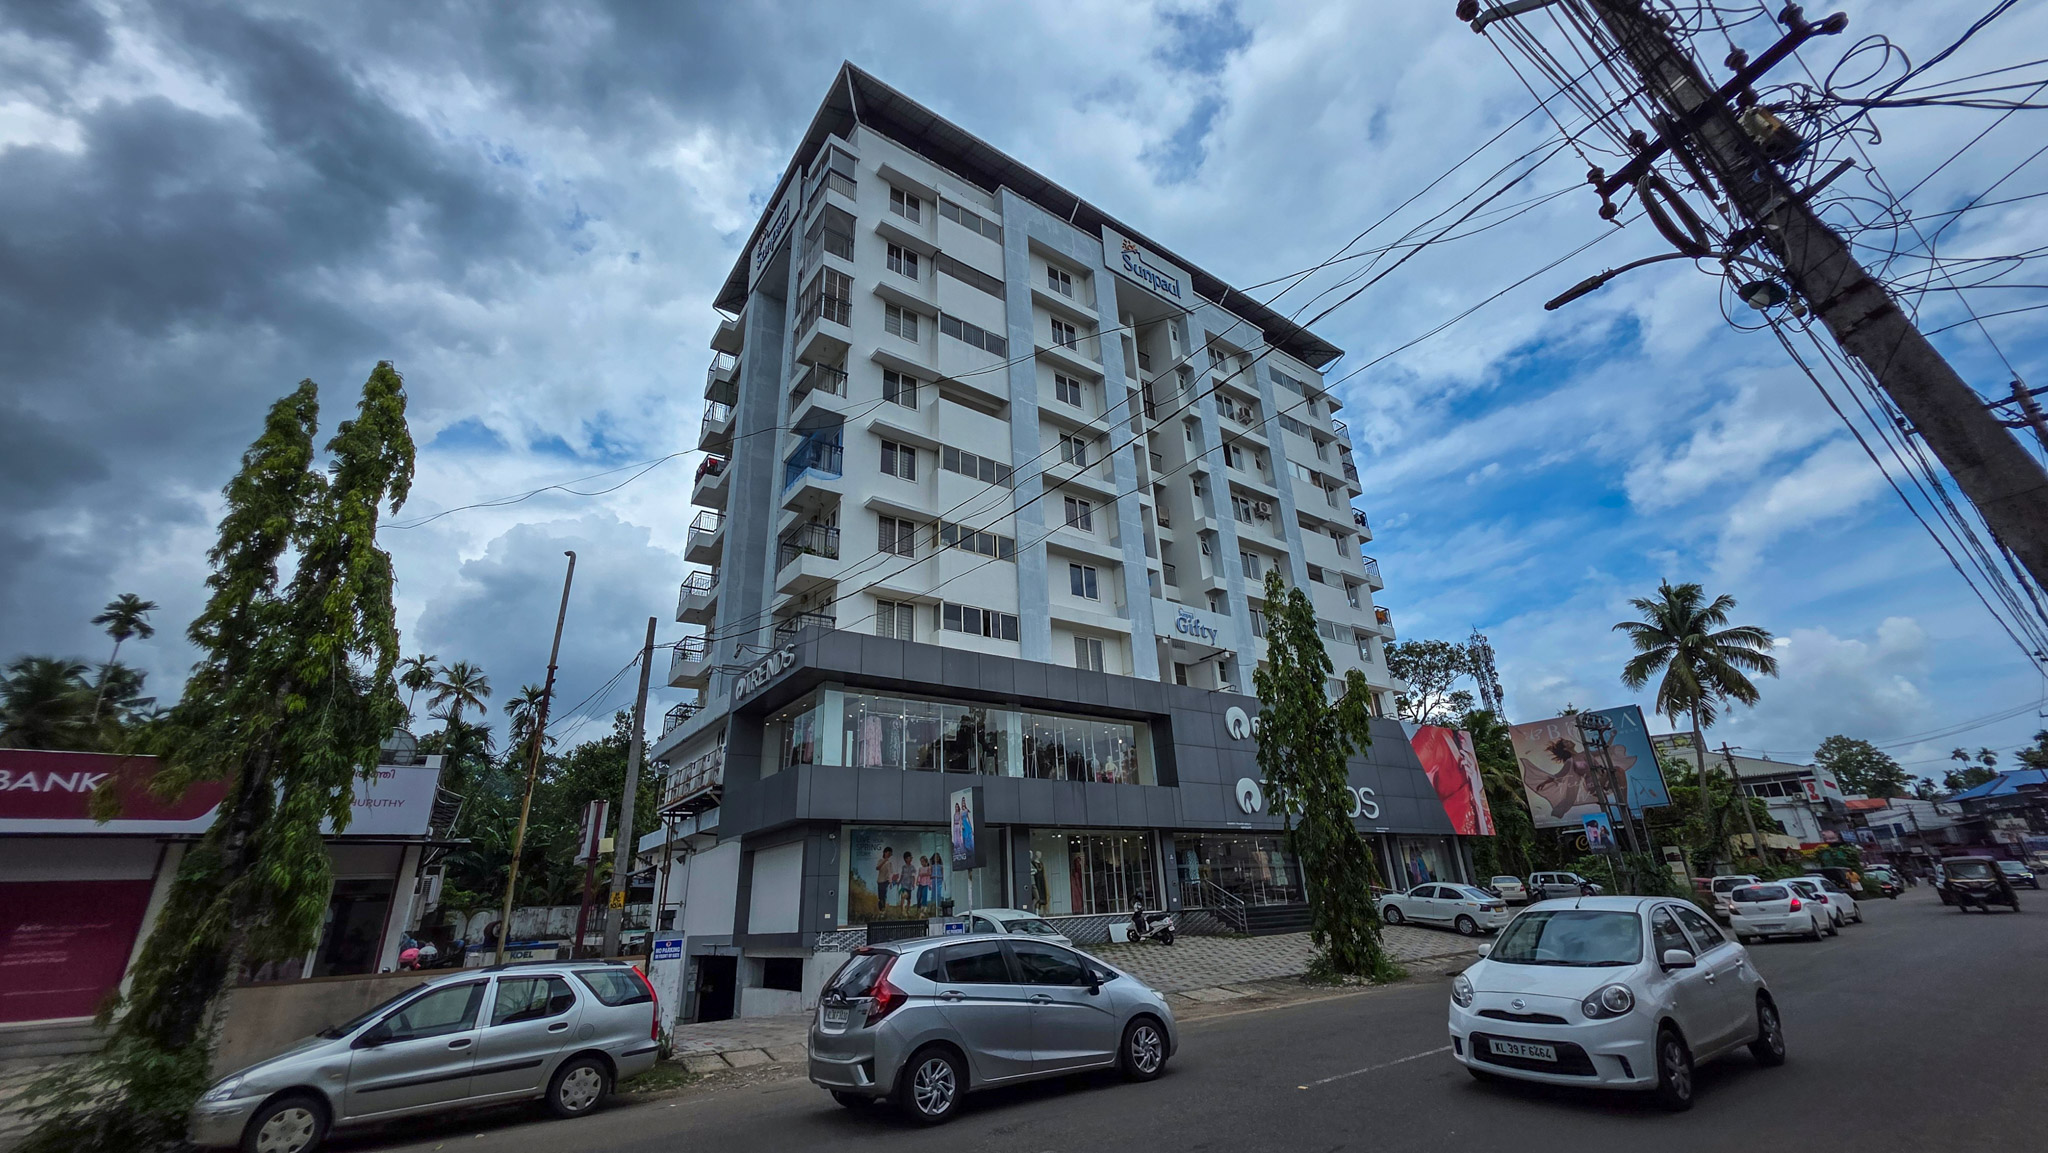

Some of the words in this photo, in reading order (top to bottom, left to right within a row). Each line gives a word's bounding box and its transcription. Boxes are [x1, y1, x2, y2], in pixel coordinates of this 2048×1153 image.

[1121, 253, 1182, 299] Sunpaul
[1176, 617, 1218, 646] Gifty
[745, 643, 795, 694] TRENDS
[510, 951, 533, 959] KOEL
[1495, 1042, 1506, 1053] KL
[1507, 1043, 1519, 1054] 39
[1520, 1045, 1527, 1055] F
[1528, 1045, 1552, 1059] 6464
